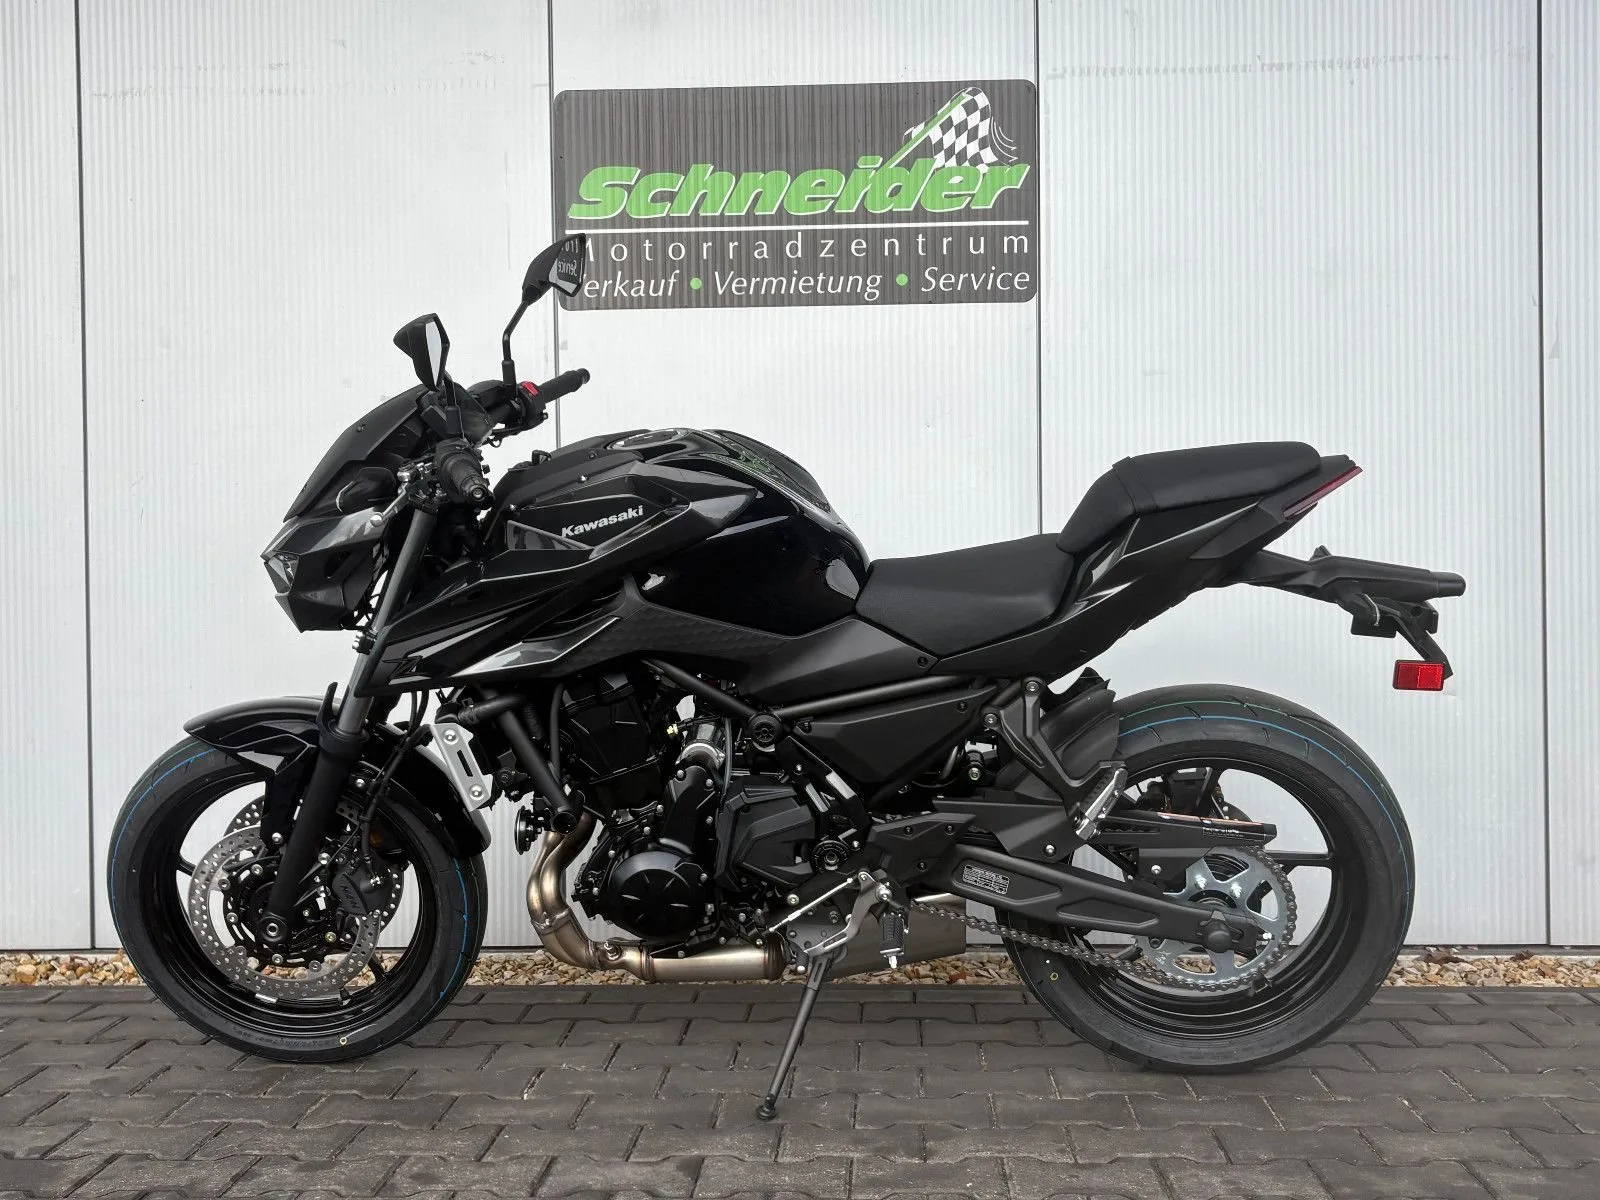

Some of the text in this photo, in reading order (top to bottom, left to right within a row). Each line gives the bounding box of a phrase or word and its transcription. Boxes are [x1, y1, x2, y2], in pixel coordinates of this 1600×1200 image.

[567, 155, 1031, 220] Schneider
[583, 265, 1030, 301] erkauf Vermietung Service
[561, 504, 643, 538] Kawasaki
